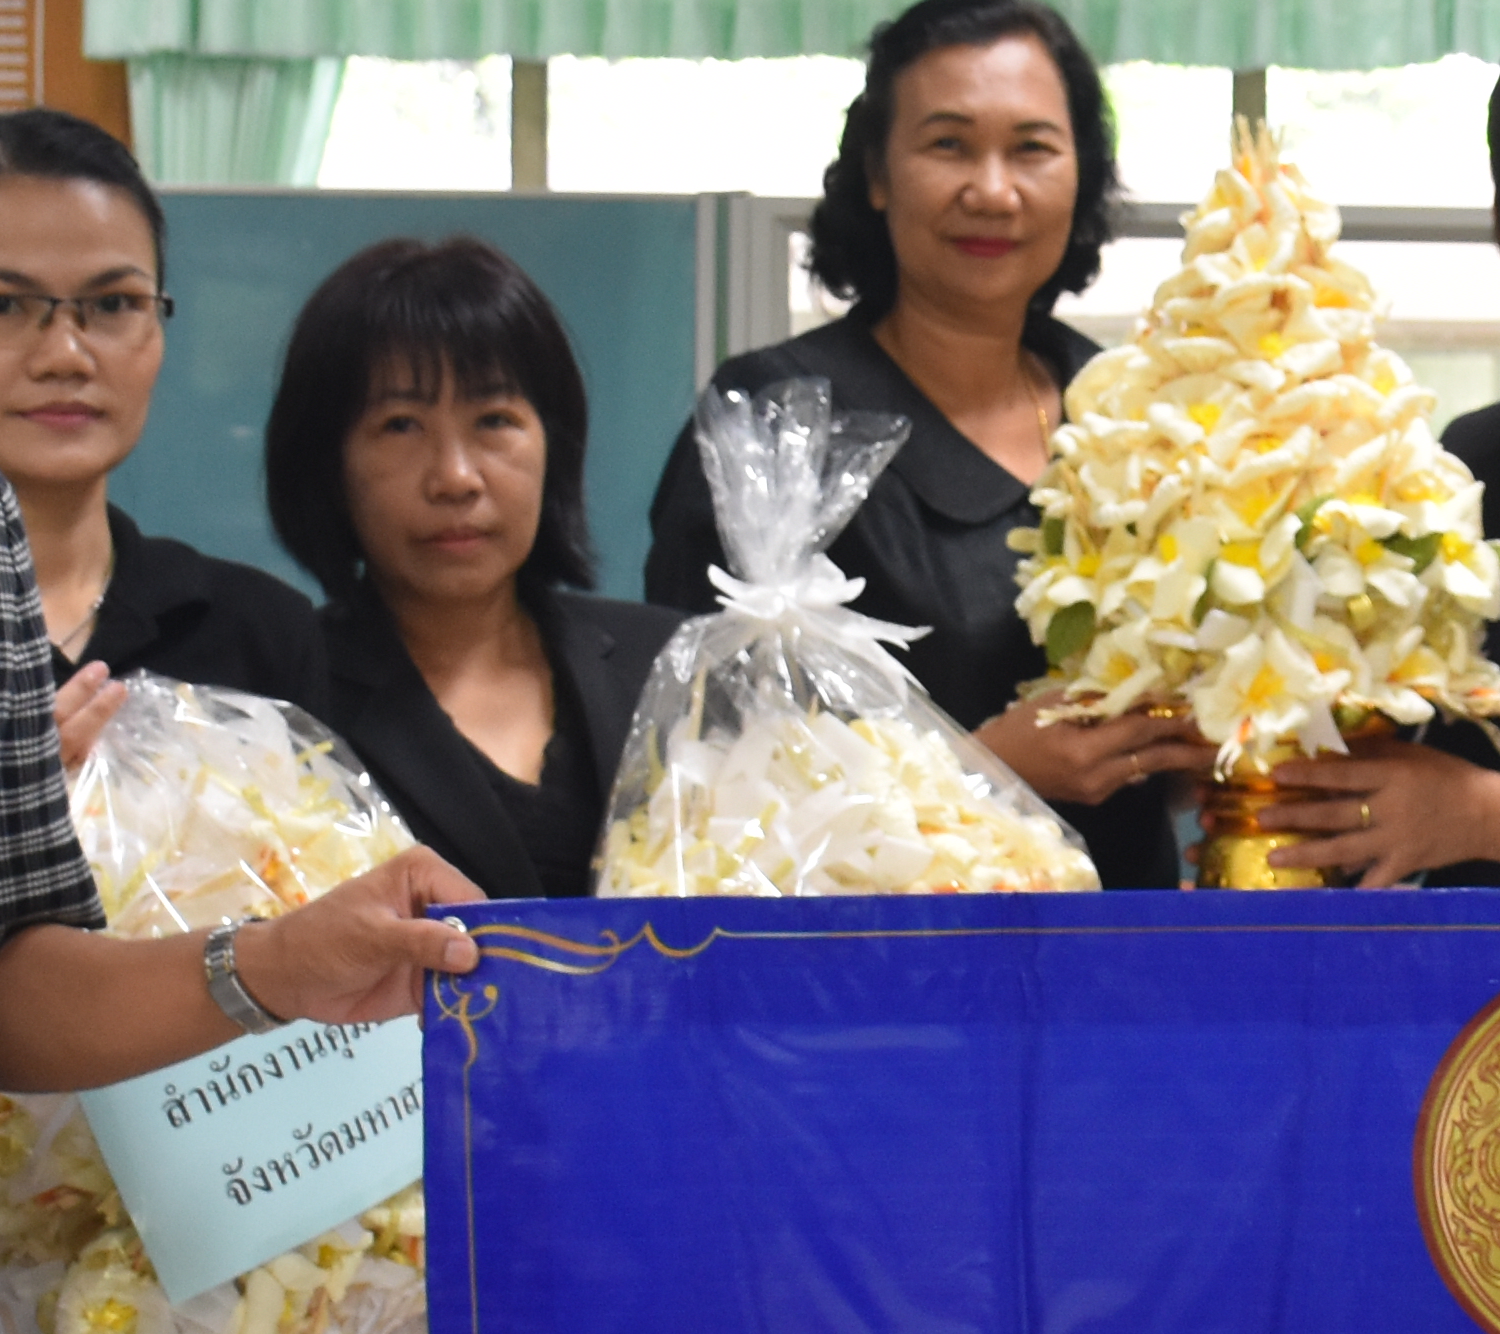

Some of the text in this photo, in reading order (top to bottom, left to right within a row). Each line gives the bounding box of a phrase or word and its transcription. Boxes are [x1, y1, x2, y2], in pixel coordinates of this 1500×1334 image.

[162, 1022, 380, 1130] สำนักงานคุม
[222, 1076, 423, 1206] จังหวัดมหาส
